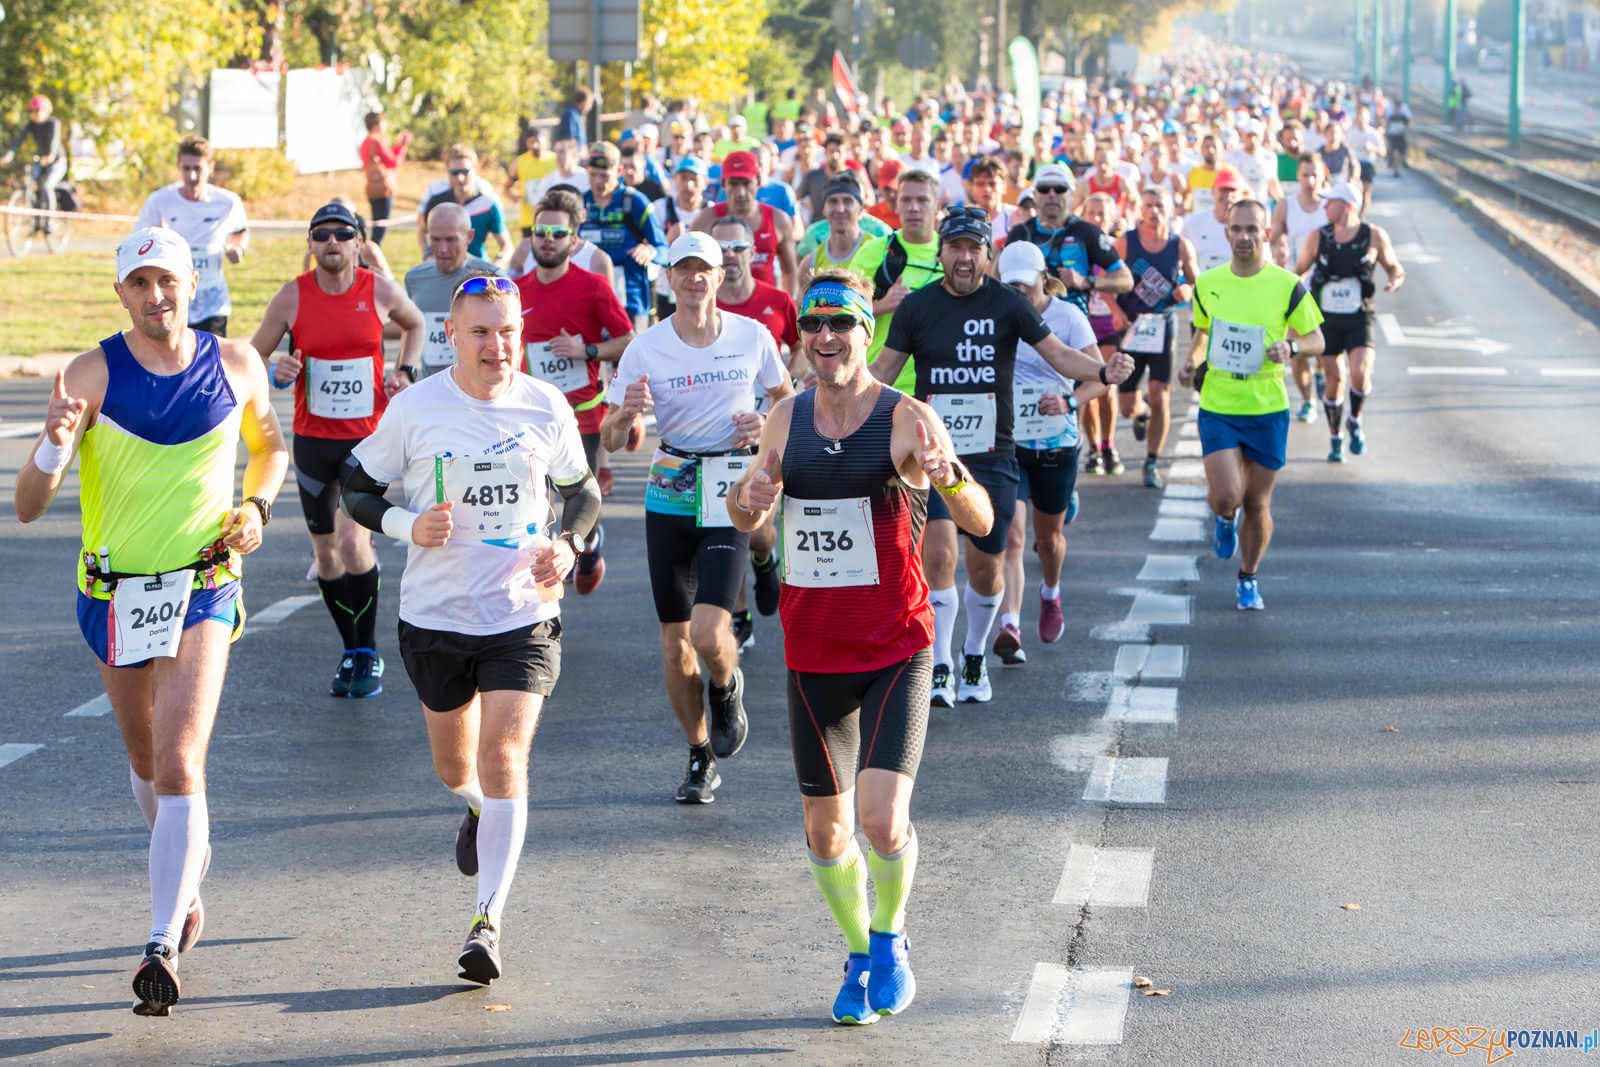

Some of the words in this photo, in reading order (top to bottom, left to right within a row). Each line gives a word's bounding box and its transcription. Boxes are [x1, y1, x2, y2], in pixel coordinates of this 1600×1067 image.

[963, 318, 995, 336] on
[956, 338, 995, 362] the
[1221, 338, 1252, 354] 4119
[540, 358, 574, 374] 1601
[930, 366, 996, 385] move
[320, 380, 363, 395] 4730
[943, 415, 983, 430] 5677
[462, 484, 520, 507] 4813
[796, 529, 853, 552] 2136
[816, 556, 834, 564] Piotr
[149, 625, 169, 637] Daniel
